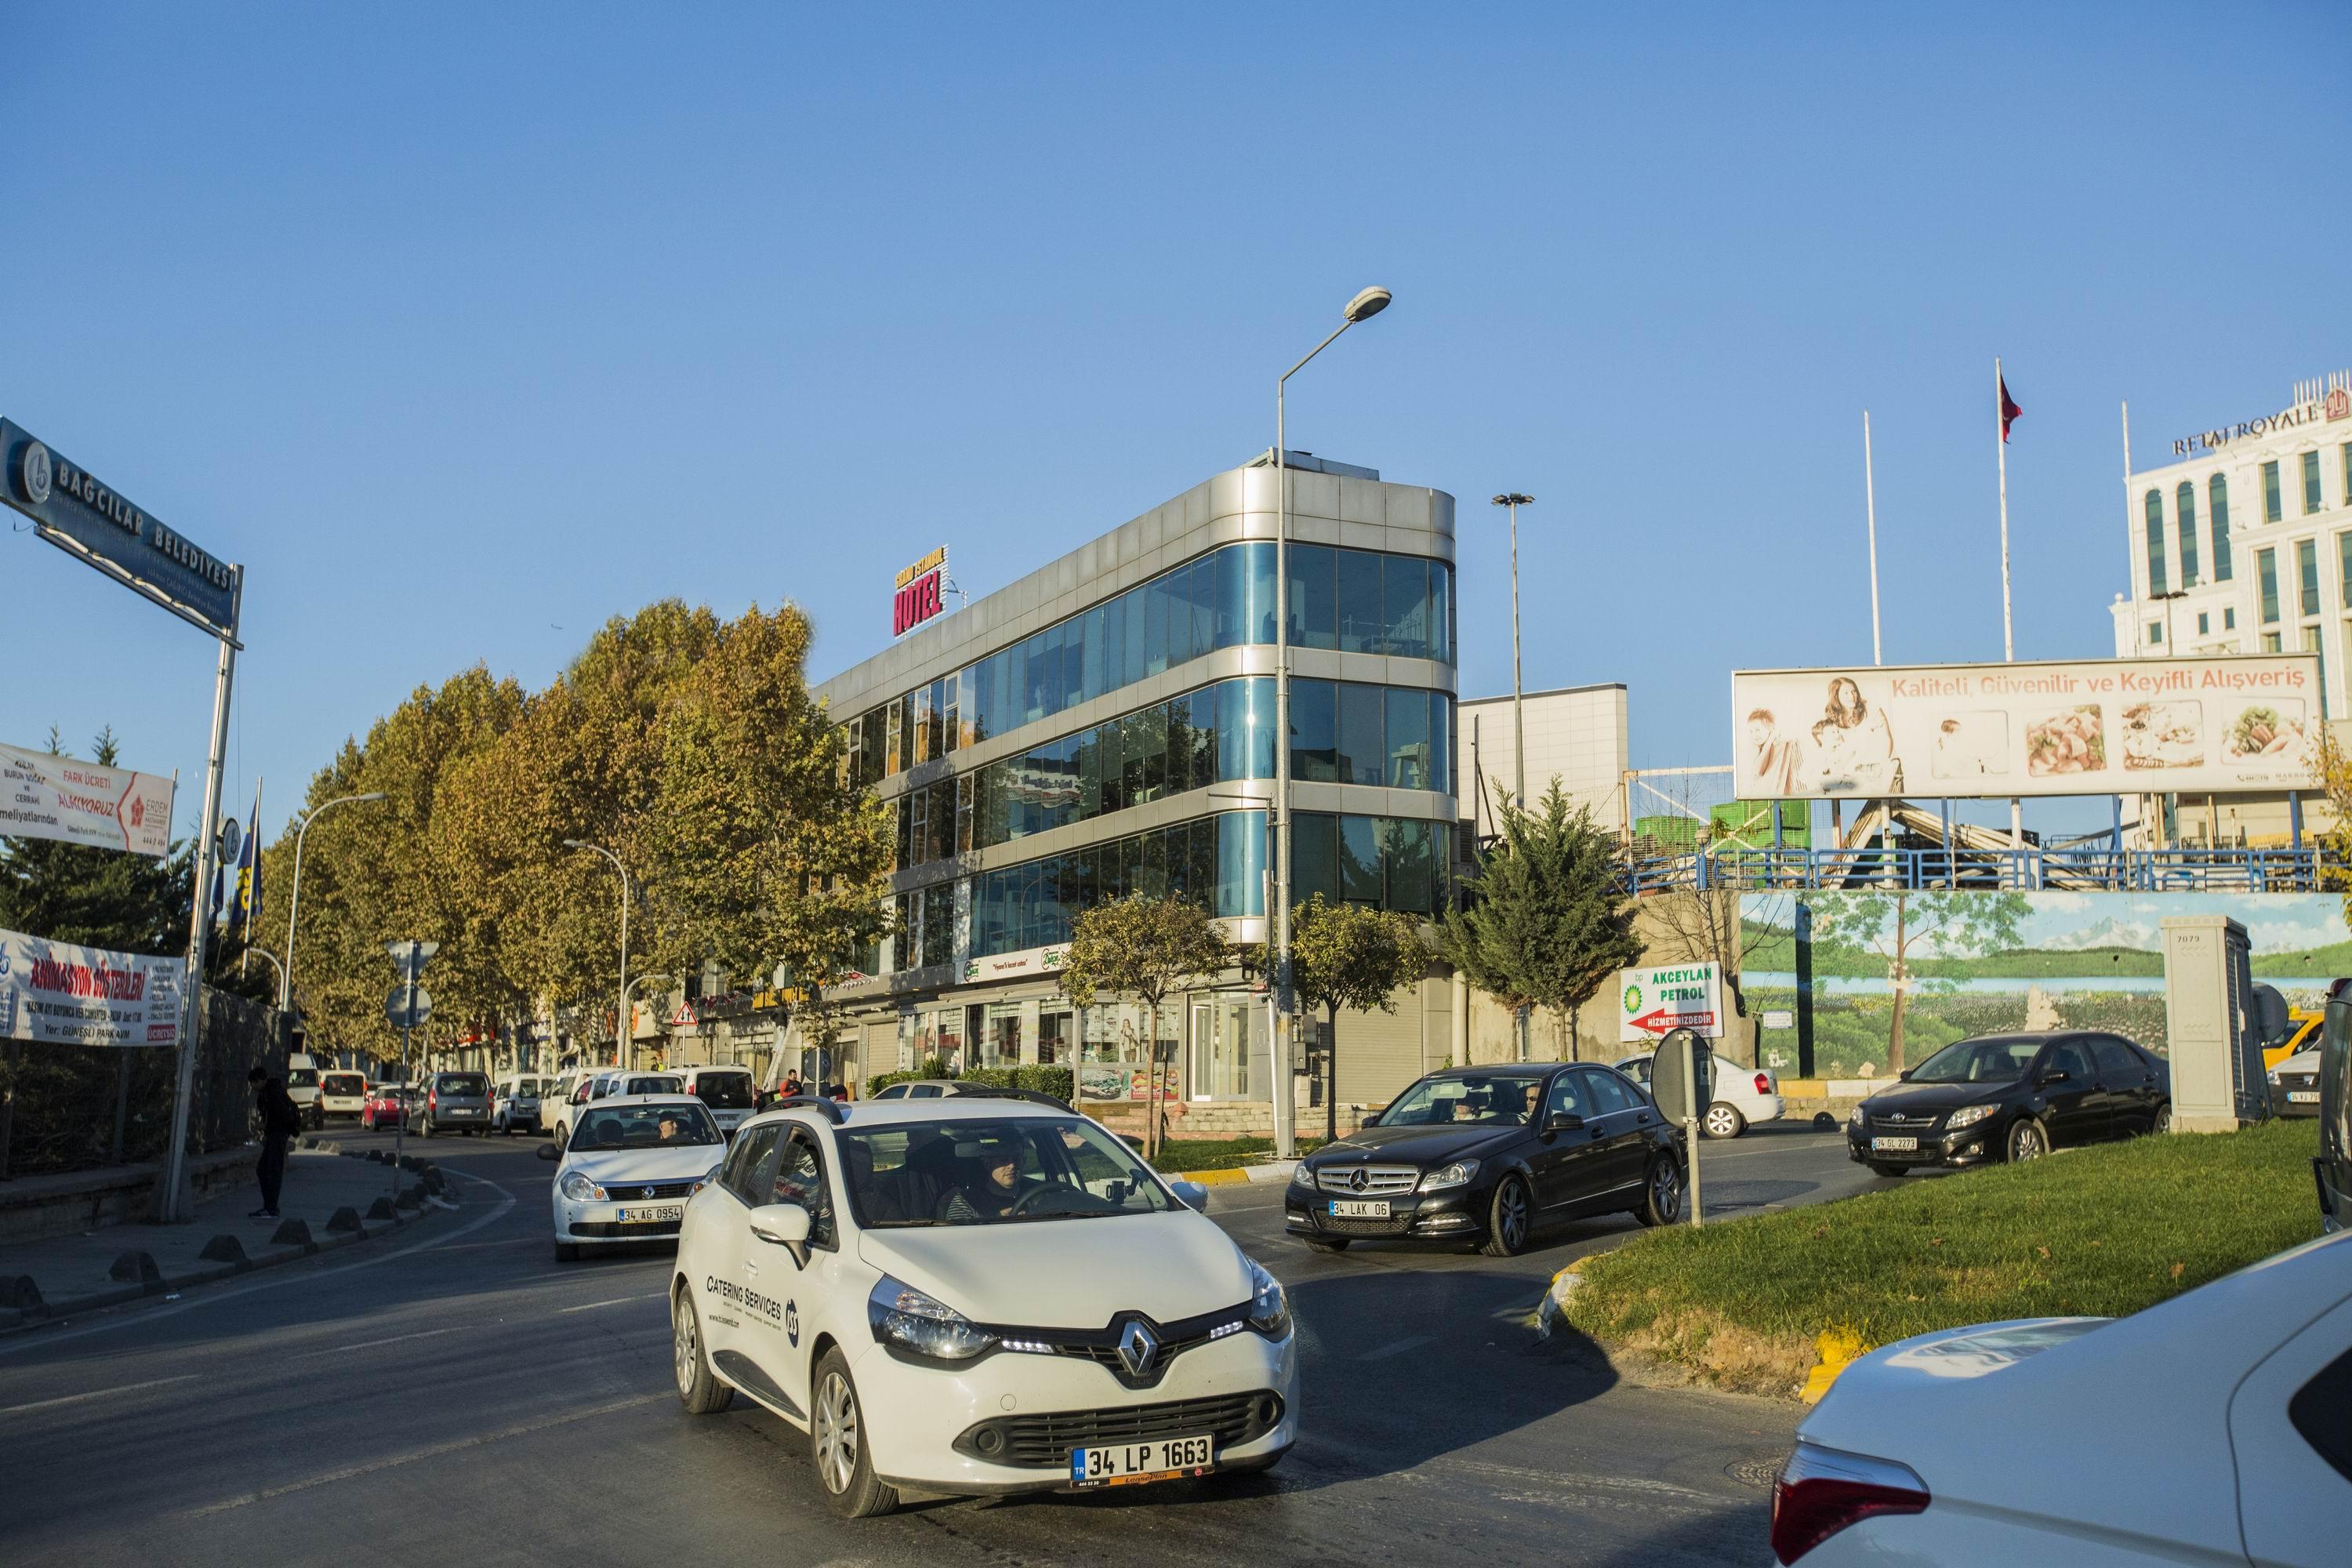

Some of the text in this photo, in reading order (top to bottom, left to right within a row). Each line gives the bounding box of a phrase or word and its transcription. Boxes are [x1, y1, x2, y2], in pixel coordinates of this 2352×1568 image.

[2173, 427, 2229, 456] RETAJ
[2237, 405, 2319, 439] ROYALE
[60, 462, 143, 536] BAĞCILAR
[894, 570, 942, 637] HOTEL
[1892, 666, 2305, 698] Kaliteli, Güvenilir ve Keyifli Alışveriş
[4, 769, 24, 780] BURUN
[63, 770, 111, 789] FARK ÜCRETİ
[58, 793, 114, 817] ALMIYORUZ
[146, 799, 169, 814] ERDEM
[30, 951, 93, 996] ANİMASYON
[93, 959, 146, 1001] GÖSTERİLERİ
[1635, 972, 1643, 982] bp
[1652, 967, 1712, 985] AKCEYLAN
[1661, 987, 1705, 1002] PETROL
[1647, 1013, 1711, 1027] HİZMETİNİZDEDİR
[45, 1024, 60, 1035] Yer:
[96, 1028, 114, 1039] PARK
[116, 1029, 130, 1040] AVM
[1877, 1138, 1885, 1148] 34
[1898, 1138, 1915, 1148] 2273
[625, 1210, 636, 1220] 34
[641, 1209, 652, 1220] AG
[657, 1208, 680, 1218] 0954
[1334, 1203, 1345, 1214] 34
[1351, 1203, 1367, 1215] LAK
[1375, 1203, 1387, 1215] 06
[706, 1276, 782, 1320] CATERING SERVICES
[1089, 1450, 1115, 1476] 34
[1126, 1446, 1151, 1472] LP
[1162, 1439, 1208, 1468] 1663
[1125, 1473, 1167, 1483] LeasePlan
